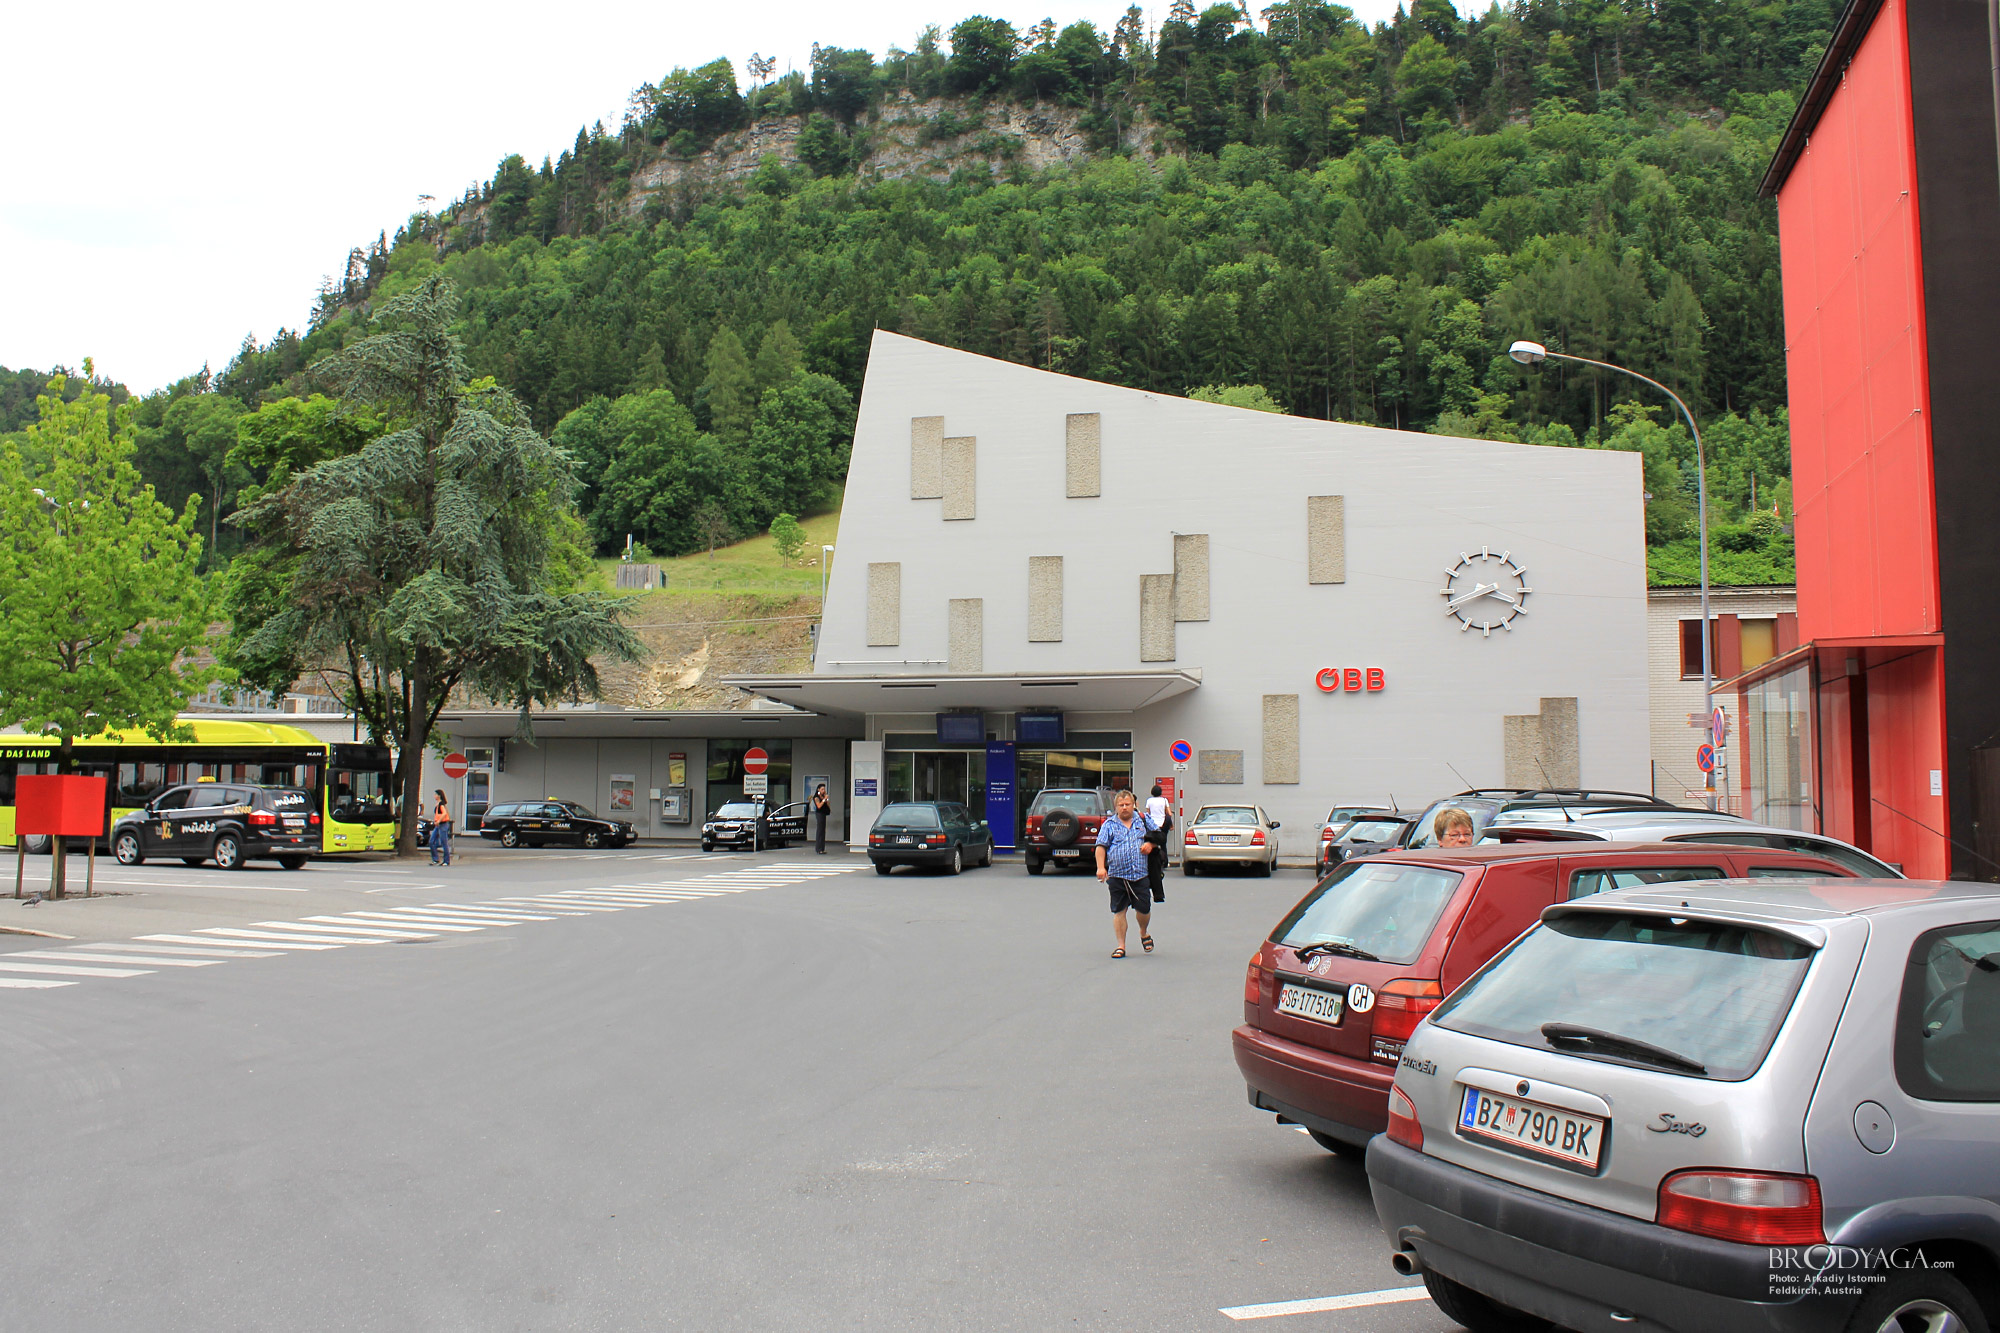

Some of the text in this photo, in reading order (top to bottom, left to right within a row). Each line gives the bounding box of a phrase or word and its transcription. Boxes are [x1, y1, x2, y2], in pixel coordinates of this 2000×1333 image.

[1316, 667, 1385, 692] ÖBB
[6, 750, 23, 758] DAS
[26, 750, 50, 758] LAND
[1352, 985, 1370, 1009] CH
[1403, 1055, 1438, 1076] CITROËN
[1477, 1096, 1593, 1157] BZ 790 BK
[1646, 1113, 1707, 1138] Saxo
